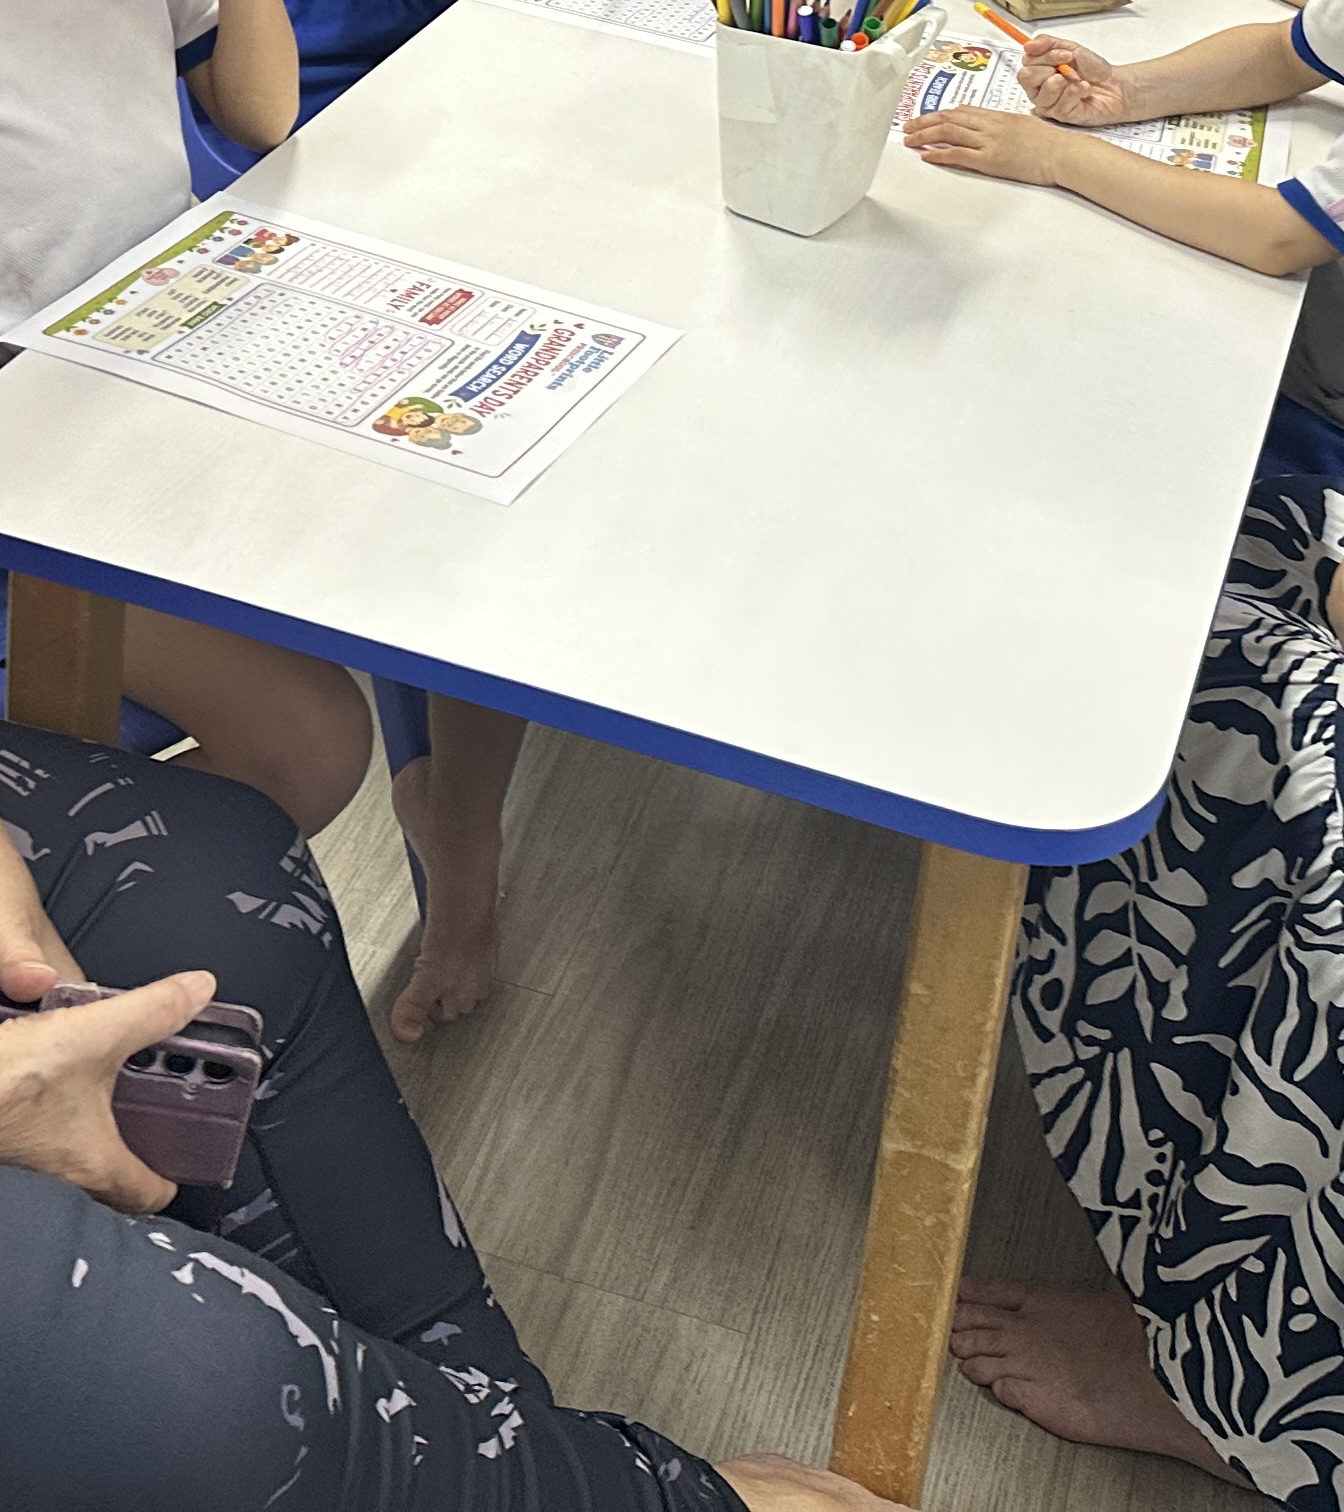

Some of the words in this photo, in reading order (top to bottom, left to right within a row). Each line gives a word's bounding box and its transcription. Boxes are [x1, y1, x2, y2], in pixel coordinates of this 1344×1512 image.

[384, 280, 433, 312] FAMILY
[490, 328, 576, 400] GRANDPARENTS
[503, 342, 531, 366] WORD
[545, 345, 603, 391] Footprints
[581, 349, 615, 374] Little
[465, 364, 507, 393] SEARCH
[468, 395, 506, 418] DAY
